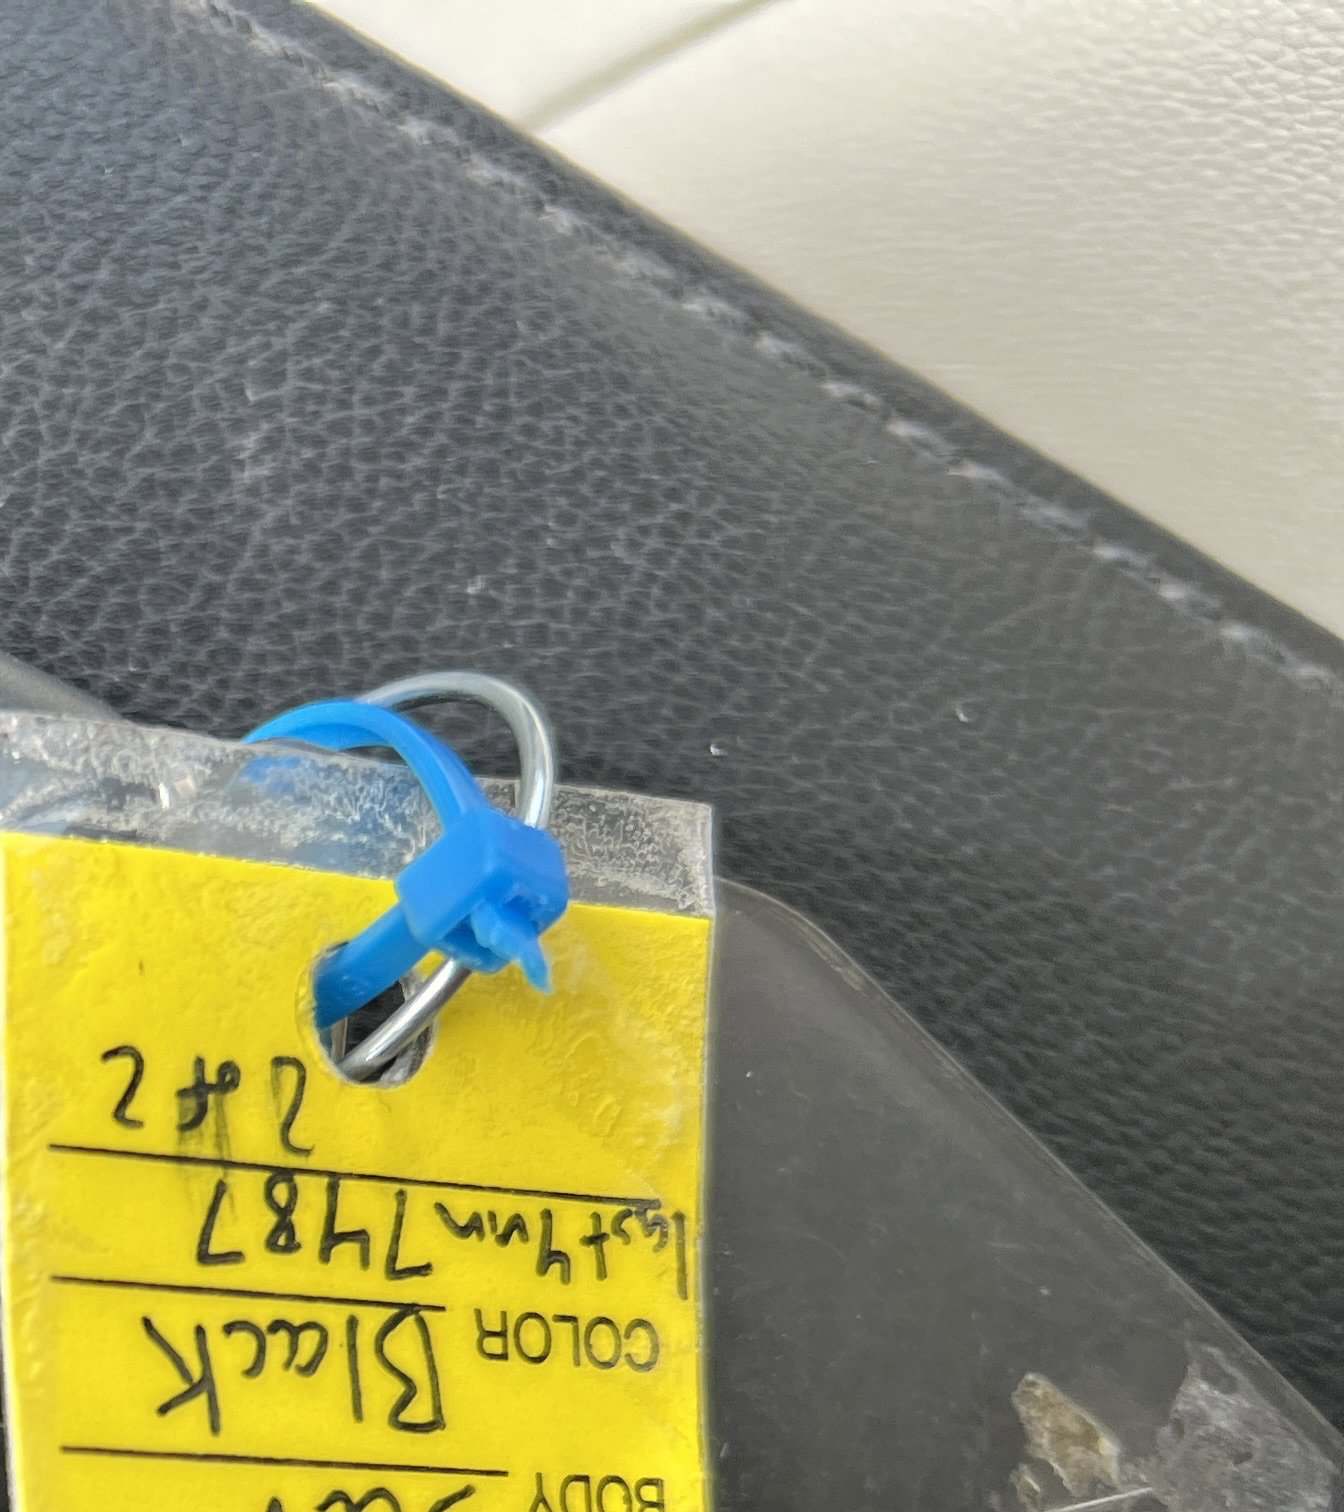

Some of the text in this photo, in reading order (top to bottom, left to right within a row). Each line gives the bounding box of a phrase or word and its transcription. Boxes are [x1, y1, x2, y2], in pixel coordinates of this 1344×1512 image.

[100, 1046, 145, 1129] 2
[197, 1174, 433, 1278] 7487
[476, 1308, 659, 1371] COLOR
